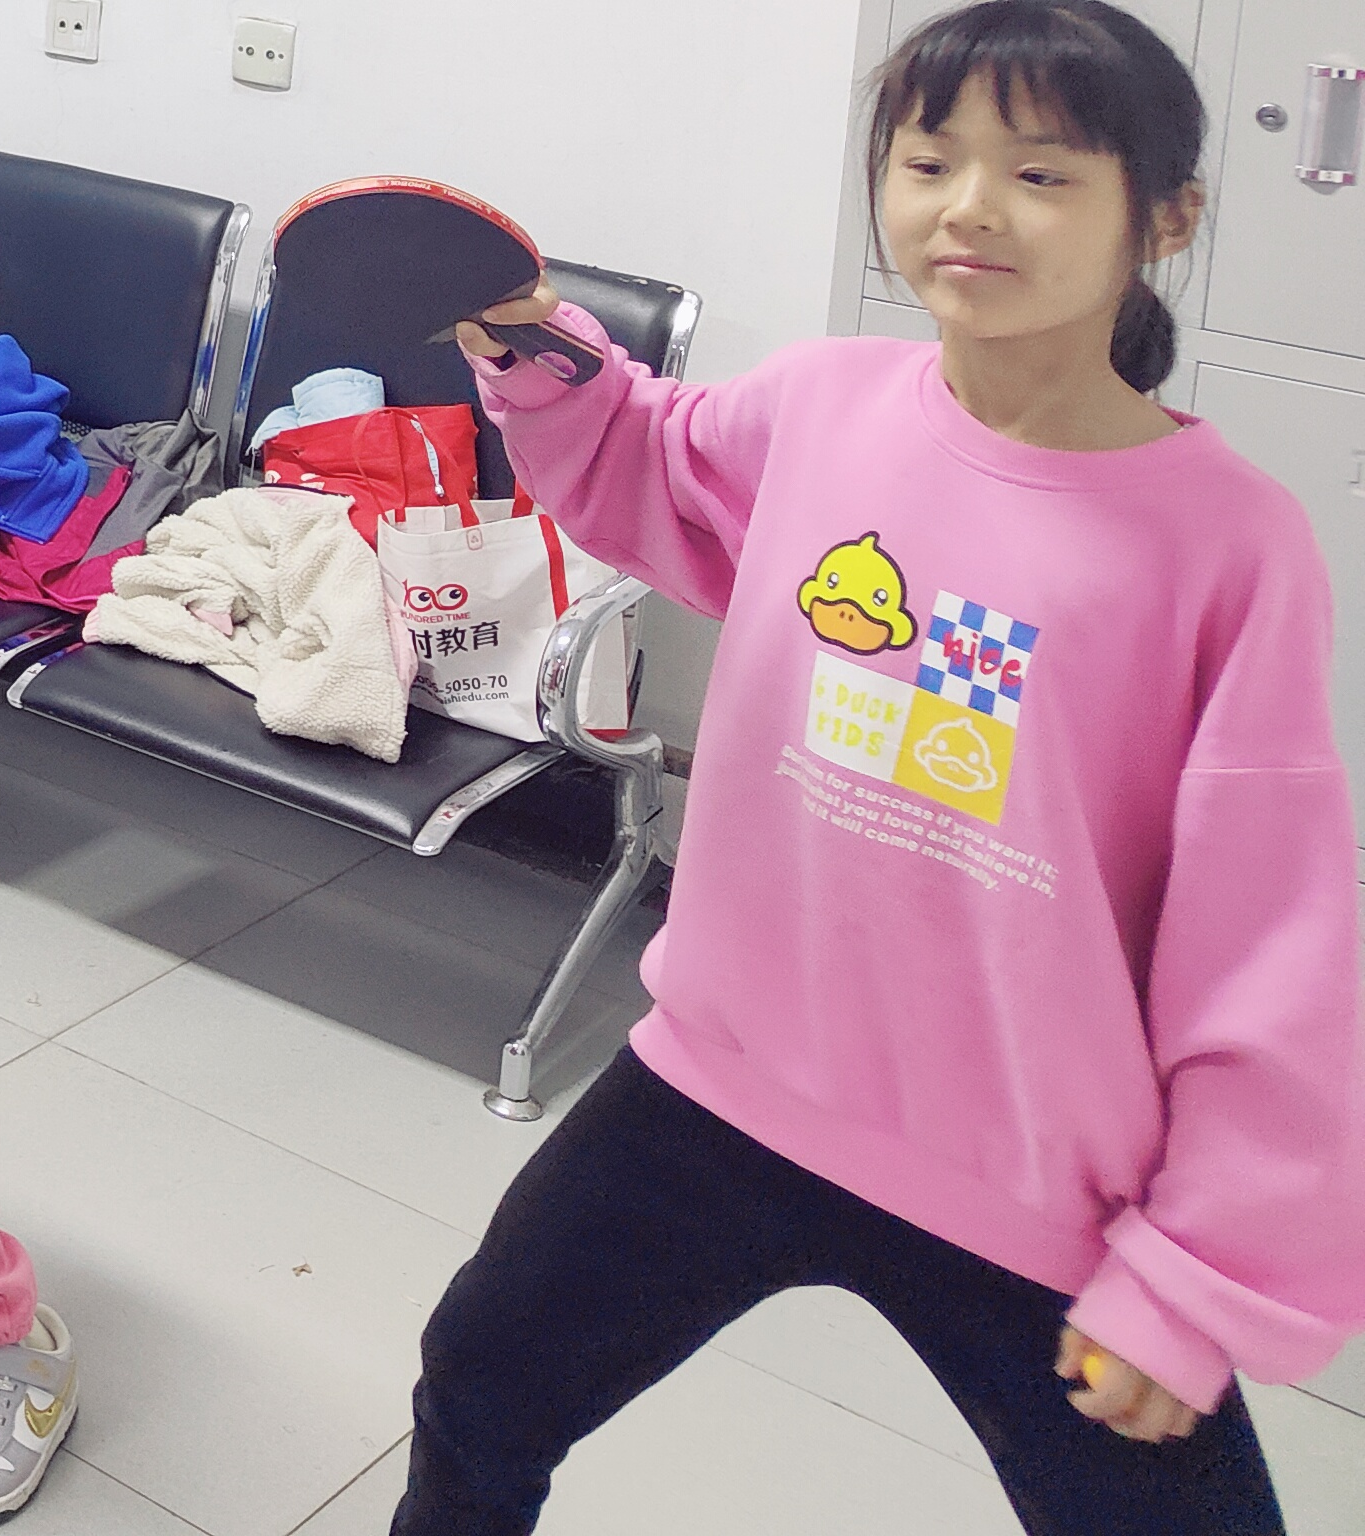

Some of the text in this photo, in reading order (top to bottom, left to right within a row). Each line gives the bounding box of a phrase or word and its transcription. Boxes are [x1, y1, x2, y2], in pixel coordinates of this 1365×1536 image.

[445, 611, 472, 623] TIME
[943, 631, 1022, 687] nice
[841, 800, 880, 822] you
[882, 811, 925, 836] love
[926, 829, 963, 851] and
[963, 844, 1029, 884] believe
[854, 786, 935, 821] success
[952, 822, 986, 845] you
[988, 838, 1036, 868] want
[864, 827, 920, 852] come
